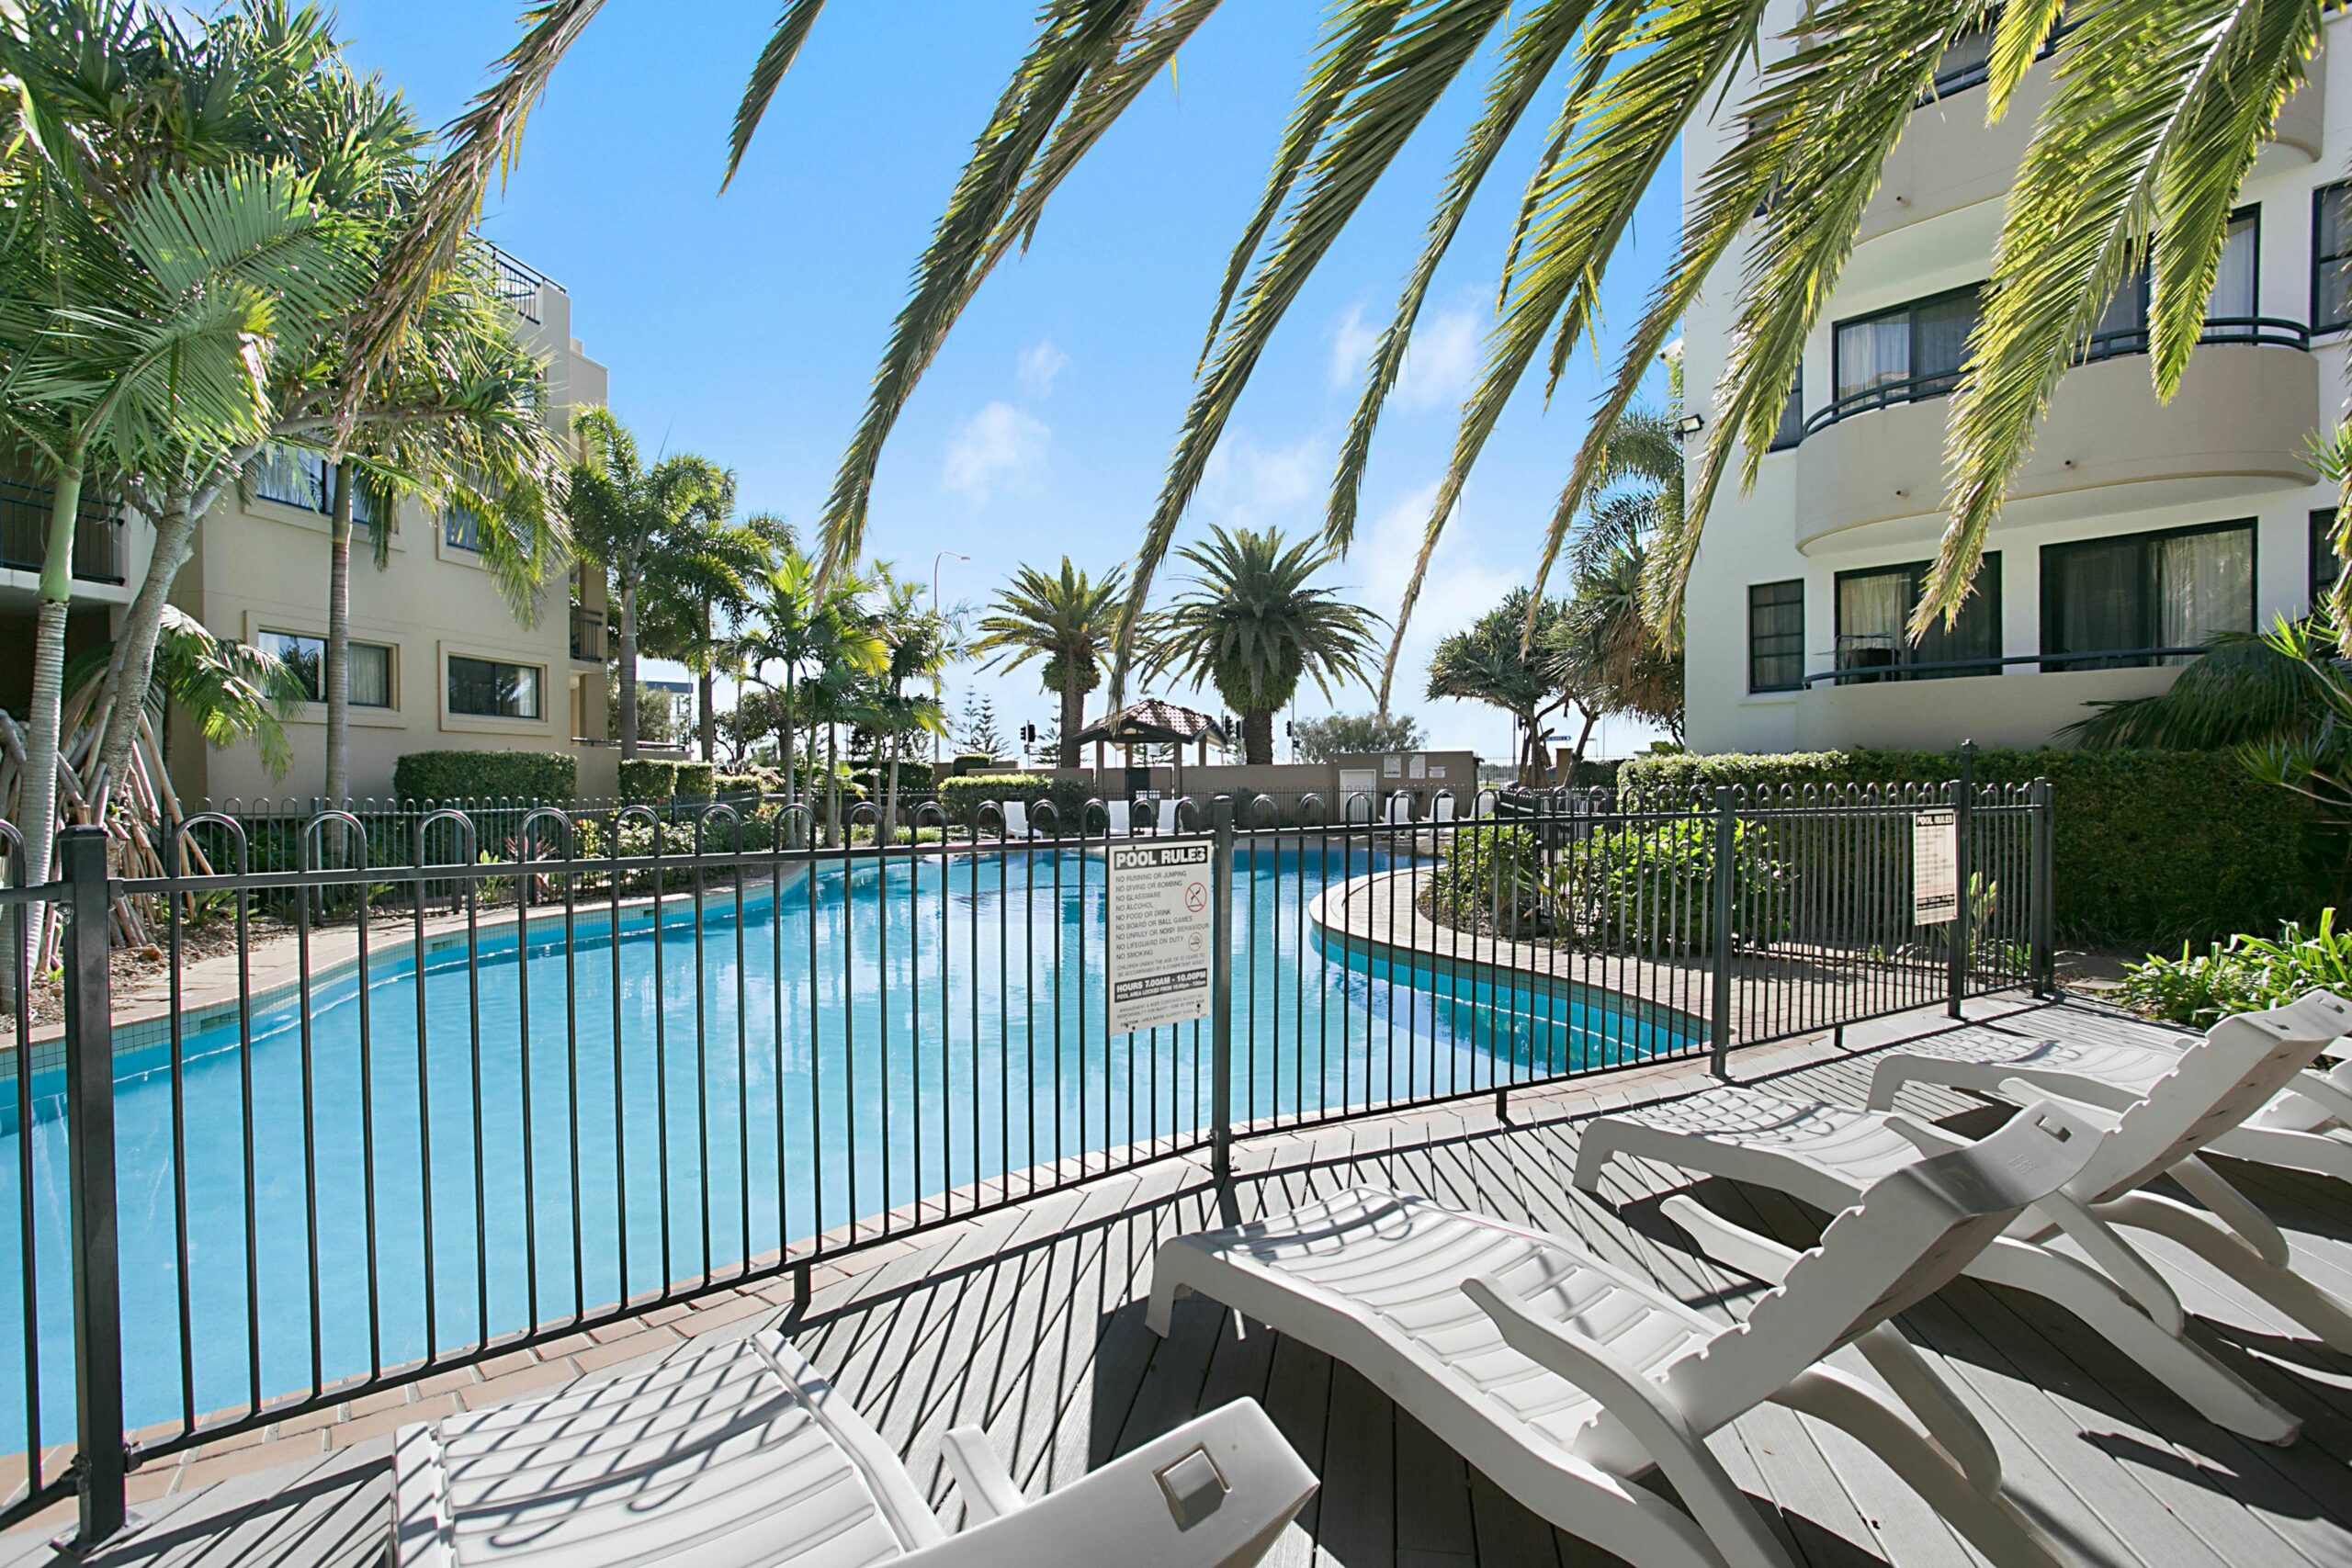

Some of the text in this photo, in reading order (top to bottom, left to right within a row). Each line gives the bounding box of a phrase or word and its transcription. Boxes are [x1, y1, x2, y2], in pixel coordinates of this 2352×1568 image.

[1917, 815, 1953, 826] POOL RULES
[1116, 848, 1205, 868] POOL RULES
[1127, 892, 1161, 901] GLASSWARE
[1127, 902, 1153, 910] ALCOHOL
[1127, 921, 1146, 929] BOARD
[1127, 931, 1147, 939] UNRULY
[1177, 923, 1209, 933] BEHAVIOUR
[1127, 939, 1157, 949] LIFEGUARD
[1127, 949, 1153, 959] SMOKING
[1117, 963, 1139, 971] CHILDREN
[1125, 967, 1155, 976] ACCOMPANIED
[1167, 961, 1191, 970] COMPETENT
[1117, 981, 1142, 993] HOURS
[1145, 977, 1170, 988] 7.00AM
[1177, 970, 1206, 982] 10.00PM
